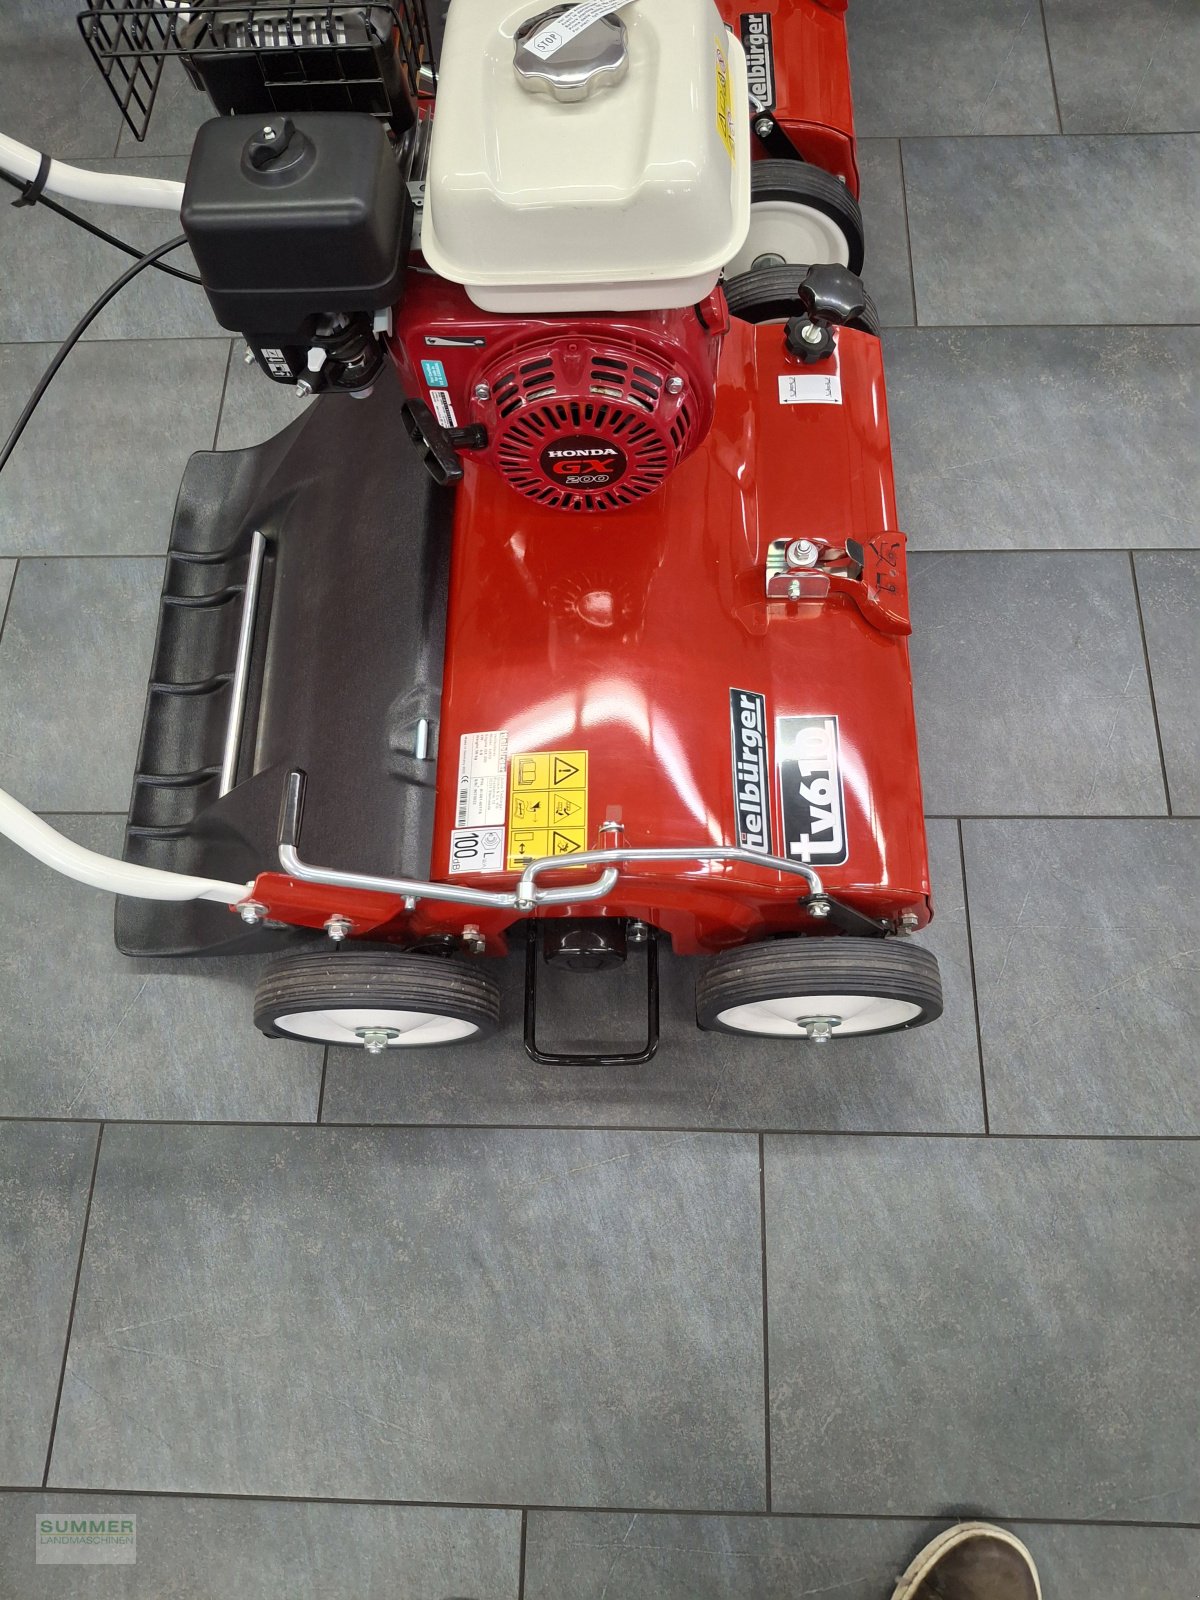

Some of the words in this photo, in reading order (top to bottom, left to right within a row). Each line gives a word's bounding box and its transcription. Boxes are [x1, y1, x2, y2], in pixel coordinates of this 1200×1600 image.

[537, 33, 558, 50] STOP
[548, 448, 618, 458] HONDA
[553, 459, 615, 474] GX
[565, 475, 610, 484] 200
[454, 833, 479, 859] 100
[452, 859, 461, 871] dB
